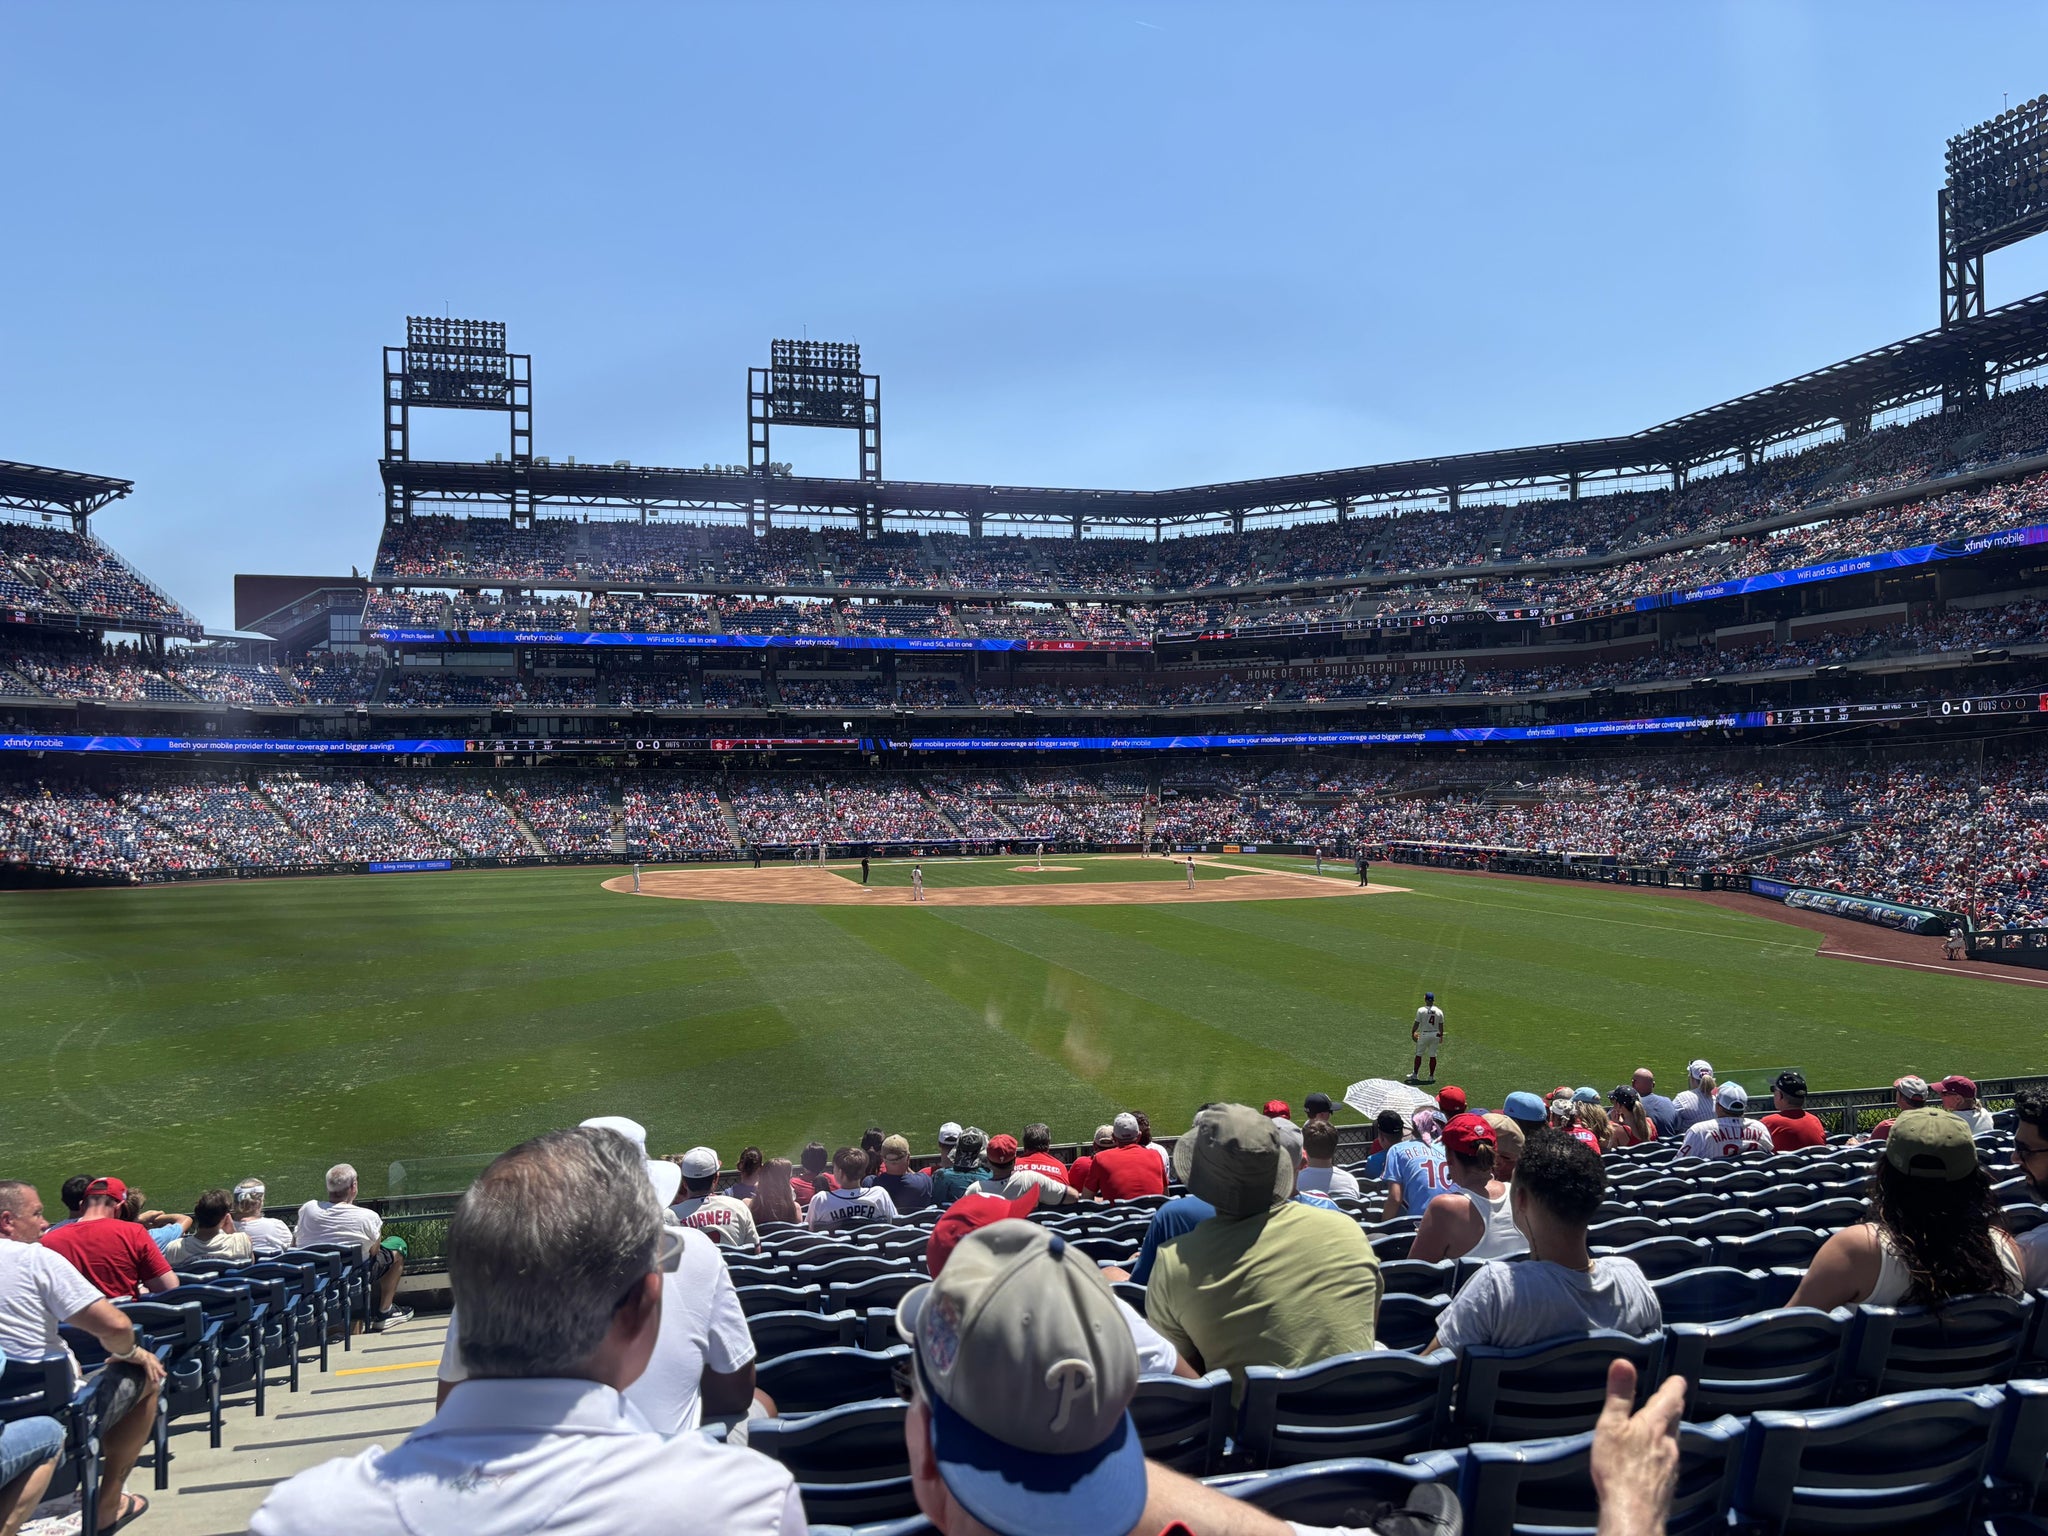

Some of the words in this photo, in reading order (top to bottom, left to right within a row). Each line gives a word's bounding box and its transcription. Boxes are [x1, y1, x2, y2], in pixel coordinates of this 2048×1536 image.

[1964, 539, 1993, 553] xfinity
[1994, 532, 2025, 546] mobile
[1797, 571, 1811, 580] WiFi
[1812, 569, 1825, 578] and
[1826, 566, 1838, 577] 5G,
[1685, 590, 1703, 601] xfinity
[1704, 586, 1724, 596] mobile
[514, 634, 538, 642] xfinity
[675, 636, 687, 644] 5G,
[794, 638, 816, 646] xfinity
[1247, 669, 1276, 680] HOME
[1281, 667, 1293, 679] OF
[1300, 667, 1319, 676] THE
[1325, 662, 1406, 675] PHILADELPHIA
[1413, 659, 1465, 672] PHILLIES
[1977, 700, 1998, 711] OUTS
[1574, 726, 1588, 734] Bench
[1599, 724, 1616, 732] mobile
[1615, 723, 1636, 731] provider
[1644, 721, 1661, 729] better
[1661, 720, 1686, 729] coverage
[1686, 719, 1697, 727] and
[1696, 719, 1715, 728] bigger
[1715, 718, 1736, 727] savings
[4, 738, 32, 748] xfinity
[34, 739, 64, 747] mobile
[1040, 740, 1058, 748] bigger
[1059, 740, 1080, 748] savings
[1111, 740, 1131, 748] xfinity
[1281, 736, 1307, 744] provider
[1381, 732, 1402, 741] bigger
[1403, 732, 1426, 740] savings
[169, 741, 191, 749] Bench
[192, 743, 209, 751] your
[209, 741, 234, 750] mobile
[234, 742, 263, 751] provider
[264, 742, 274, 750] for
[275, 742, 295, 750] better
[296, 743, 329, 752] coverage
[330, 743, 344, 751] and
[345, 743, 368, 752] bigger
[369, 743, 395, 751] savings
[1871, 907, 1882, 921] 10
[1907, 915, 1919, 931] 10
[1428, 1015, 1435, 1026] 4
[1710, 1128, 1763, 1143] HALLADAY
[1420, 1159, 1453, 1191] 10
[830, 1205, 875, 1220] HARPER
[1045, 1358, 1095, 1433] P
